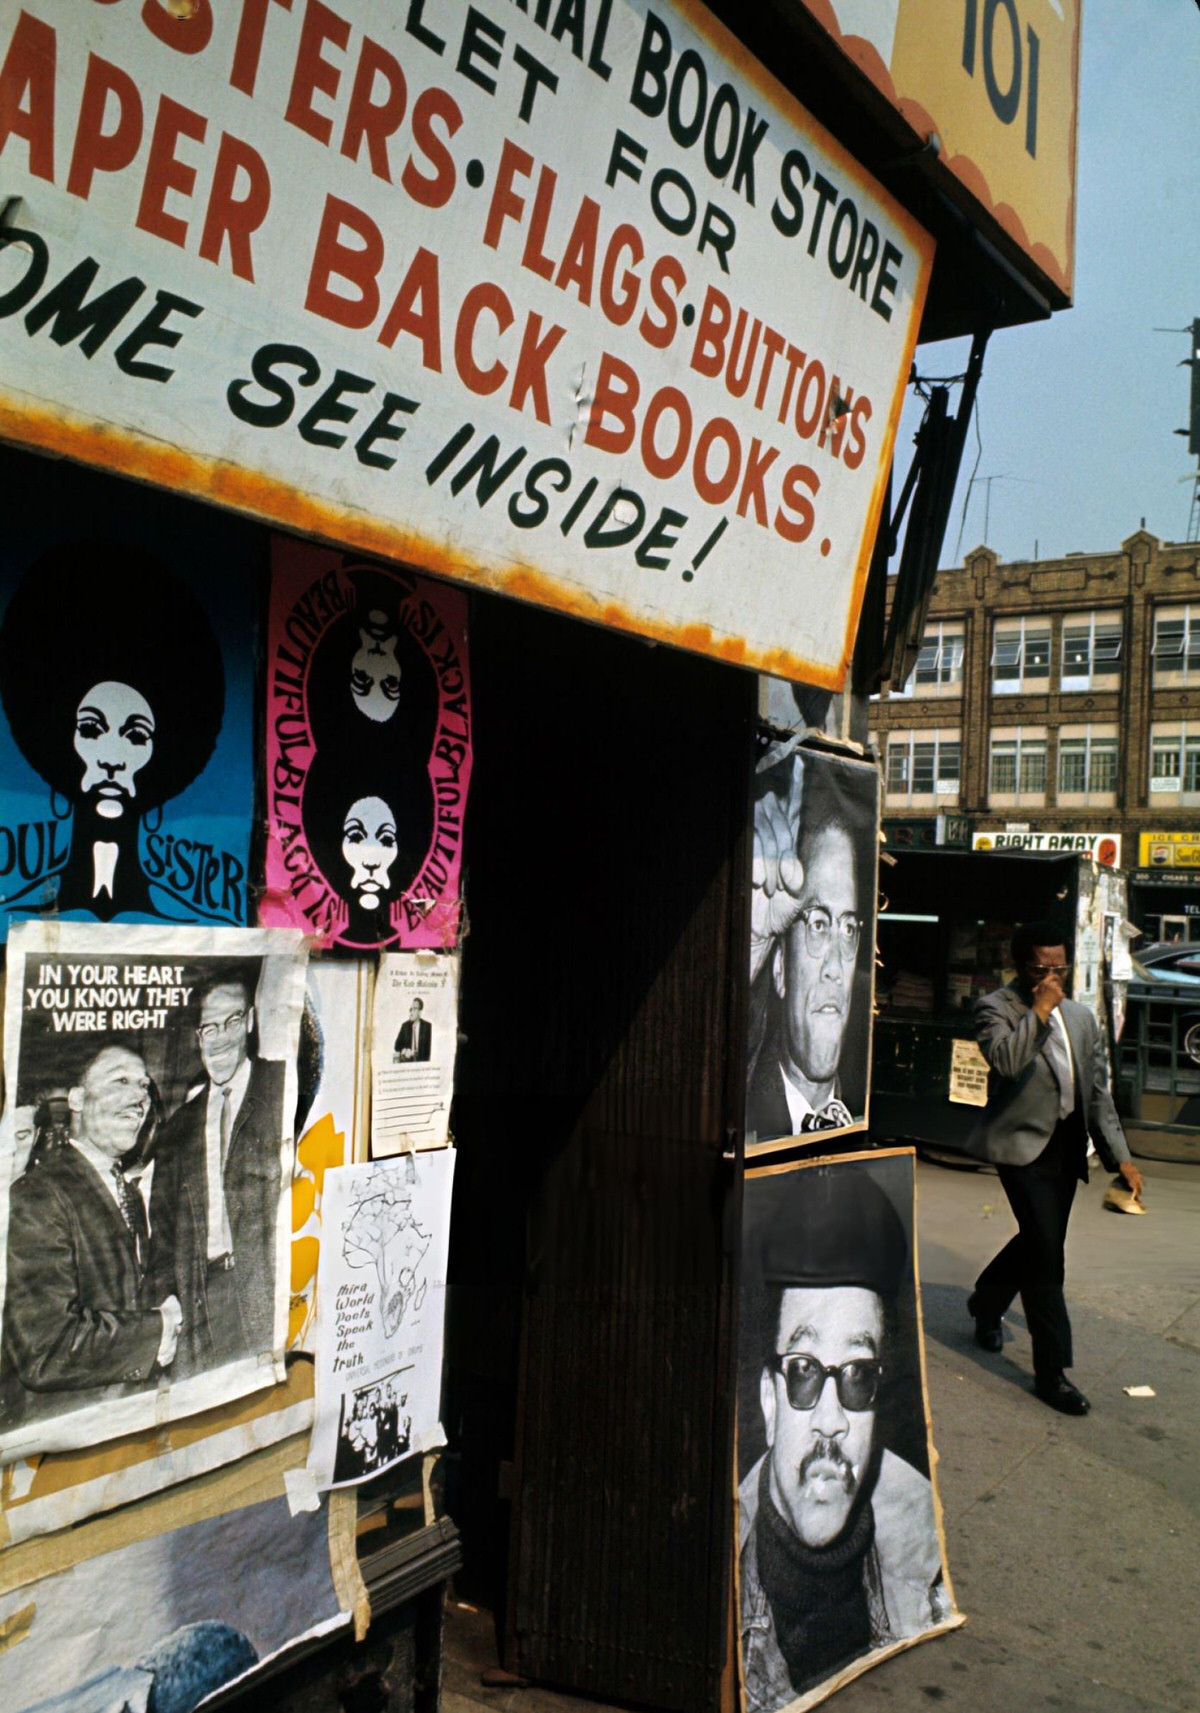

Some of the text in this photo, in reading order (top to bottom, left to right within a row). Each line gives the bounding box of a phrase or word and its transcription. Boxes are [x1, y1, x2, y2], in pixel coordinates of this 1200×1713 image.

[405, 0, 736, 274] LET FOR
[630, 9, 770, 206] BOOK
[772, 149, 903, 324] STORE
[0, 9, 831, 557] APER BACK BOOKS.
[483, 138, 686, 349] FLAGS
[690, 284, 872, 470] BUTTONS
[227, 343, 421, 471] SEE
[426, 423, 729, 582] INSIDE!
[274, 569, 343, 763] BEAUTIFUL
[434, 640, 470, 770] BLACK
[273, 757, 324, 899] BLACK
[403, 767, 461, 932] BEAUTIFUL
[995, 835, 1098, 850] RIGHT AWAY
[26, 987, 193, 1009] YOU KNOW THEY
[39, 965, 184, 985] IN YOUR HEART
[52, 1009, 168, 1032] WERE RIGHT
[336, 1293, 374, 1310] World
[336, 1320, 373, 1338] Speak
